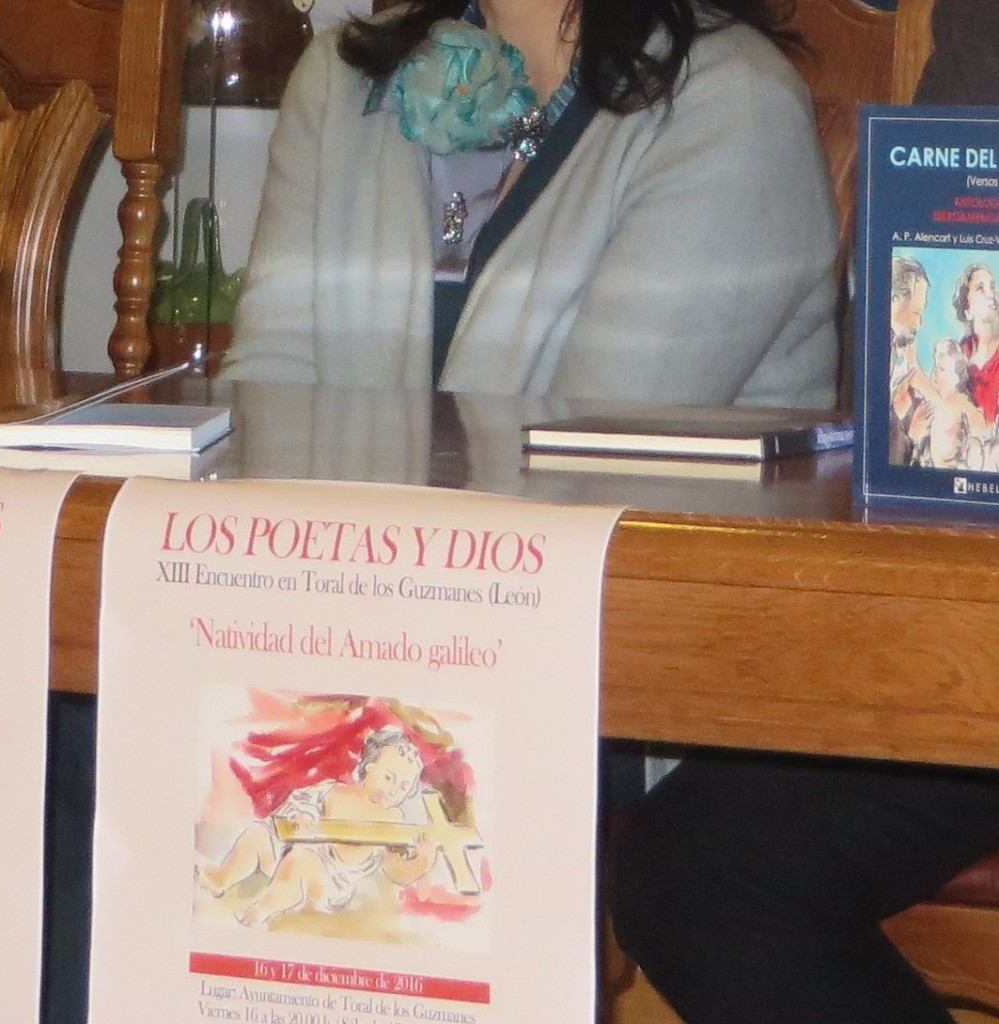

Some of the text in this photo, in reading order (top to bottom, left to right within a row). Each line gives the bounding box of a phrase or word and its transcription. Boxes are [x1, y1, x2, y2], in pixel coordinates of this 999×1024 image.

[889, 145, 998, 169] CARNE DEL
[891, 231, 902, 241] A.
[952, 235, 959, 245] y
[960, 234, 974, 244] Luis
[161, 511, 548, 575] LOS POETAS Y DIOS
[156, 560, 542, 609] XIII Encuentro en Toral de los Guzmanes (León)
[300, 624, 333, 657] del
[339, 628, 423, 662] Amado
[253, 960, 268, 977] 16
[280, 962, 295, 979] 17
[297, 964, 313, 982] de
[314, 964, 373, 989] diciembre
[375, 972, 391, 990] de
[393, 974, 424, 994] 2016
[197, 1000, 241, 1021] Viernes
[239, 984, 321, 1009] Ayuntamiento
[322, 993, 337, 1011] de
[339, 993, 373, 1015] Toral
[375, 996, 391, 1017] de
[393, 998, 411, 1019] los
[412, 1002, 478, 1024] Guzmanes
